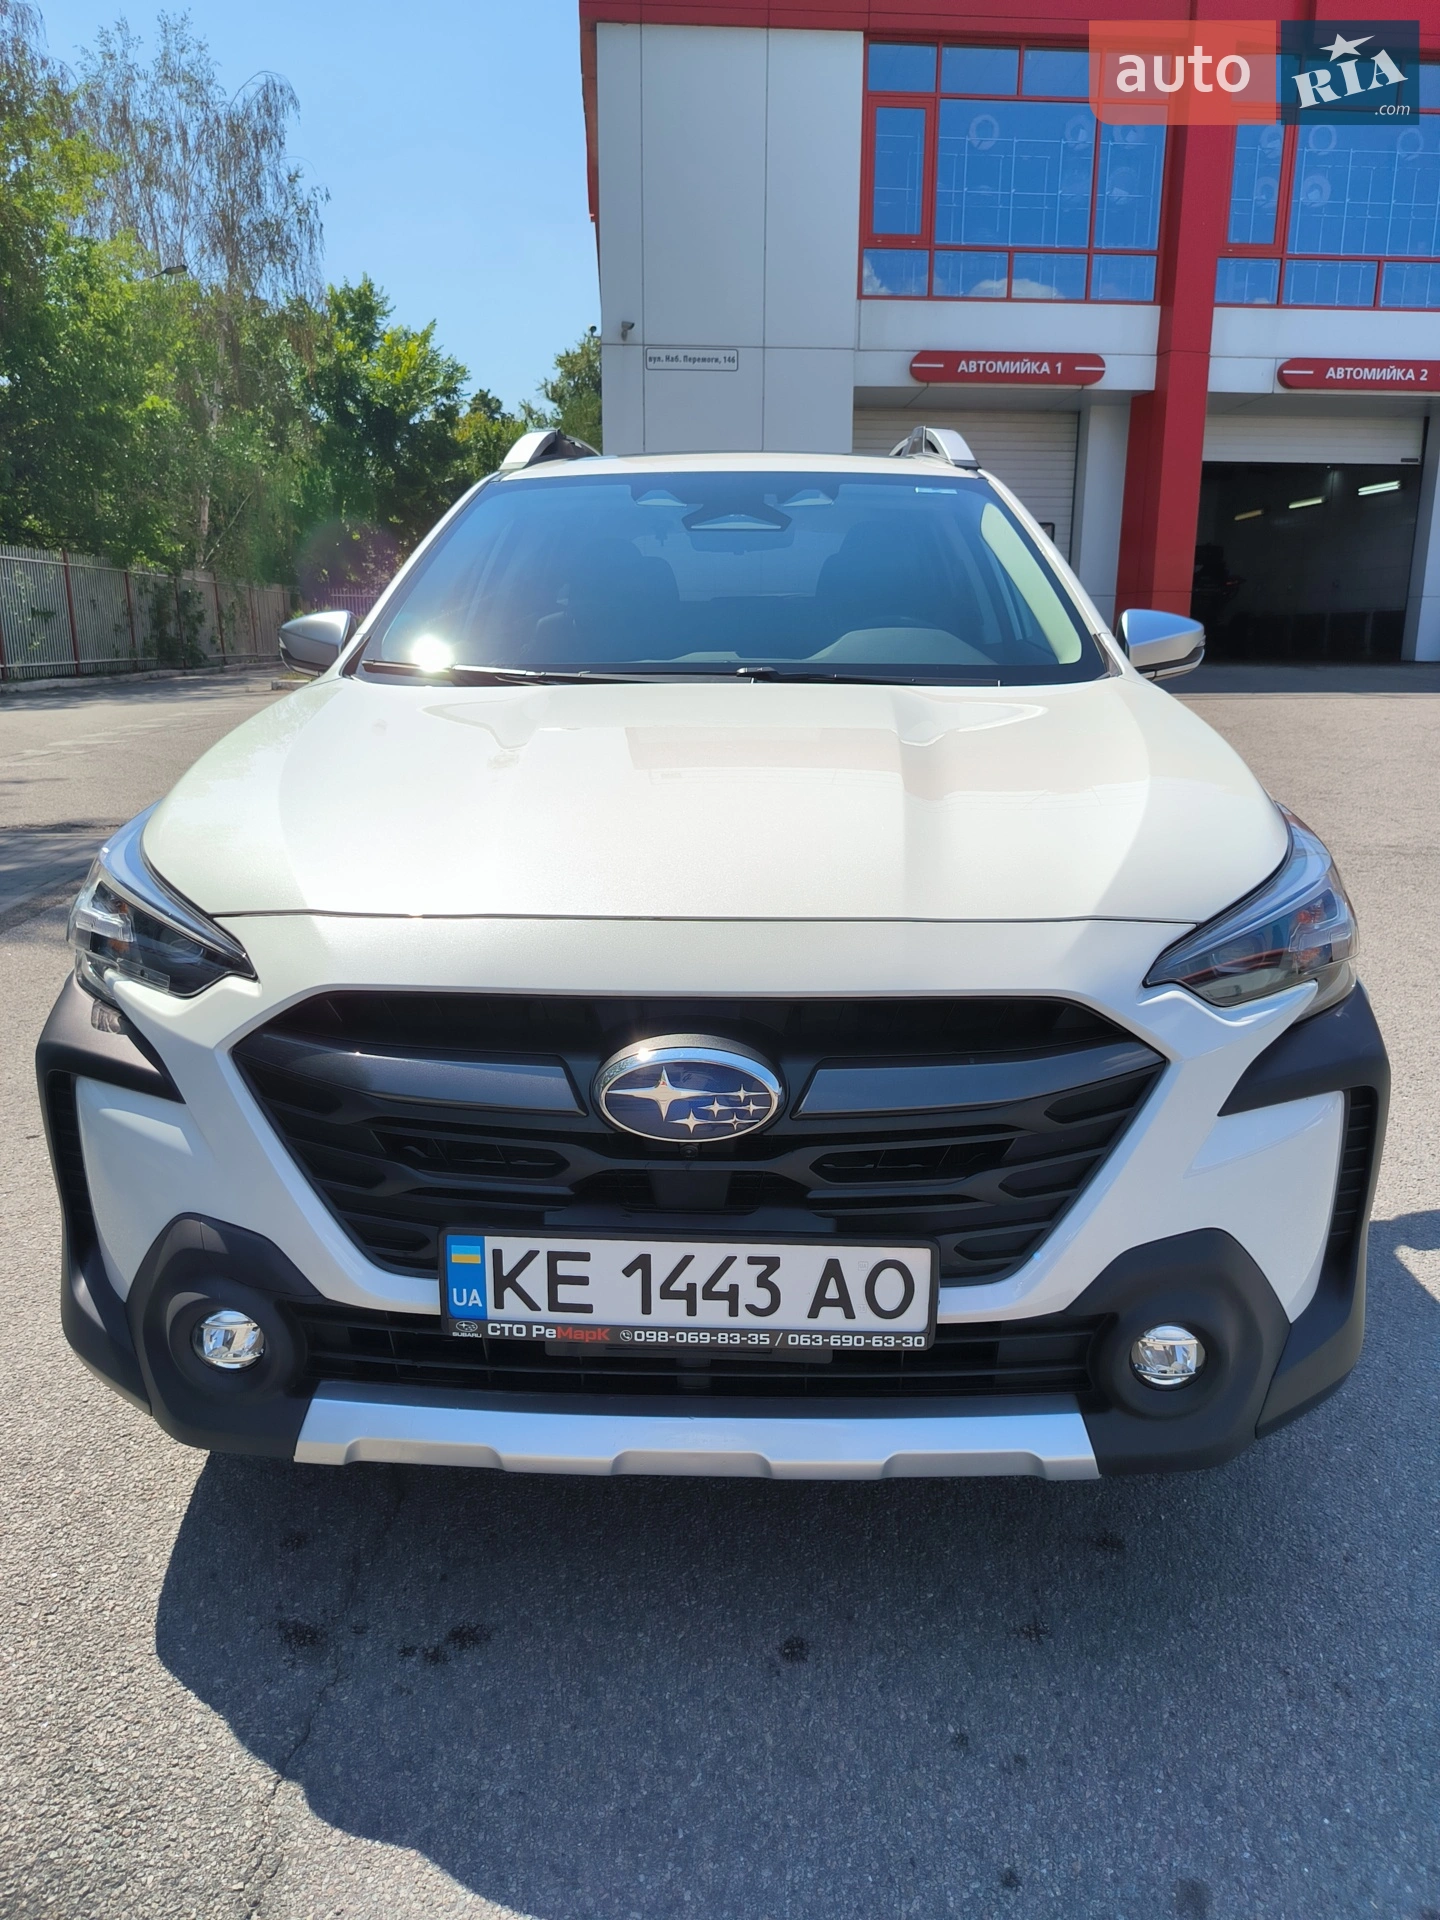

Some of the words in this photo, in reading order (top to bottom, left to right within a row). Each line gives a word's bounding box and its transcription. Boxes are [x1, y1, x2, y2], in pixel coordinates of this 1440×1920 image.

[648, 355, 664, 364] вул.
[665, 355, 682, 363] Наб.
[683, 355, 722, 365] Перемоги,
[723, 356, 736, 364] 146
[957, 358, 1051, 375] АВТОМИЙКА
[1055, 362, 1062, 374] 1
[1325, 365, 1416, 381] АВТОМИЙКА
[1419, 368, 1428, 381] 2
[491, 1248, 594, 1314] KE
[621, 1253, 781, 1318] 1443
[807, 1258, 915, 1320] AO
[452, 1288, 483, 1307] UA
[487, 1322, 527, 1337] СТО
[634, 1330, 770, 1345] 098-069-83-35
[774, 1332, 784, 1346] /
[787, 1334, 926, 1347] 063-690-63-30
